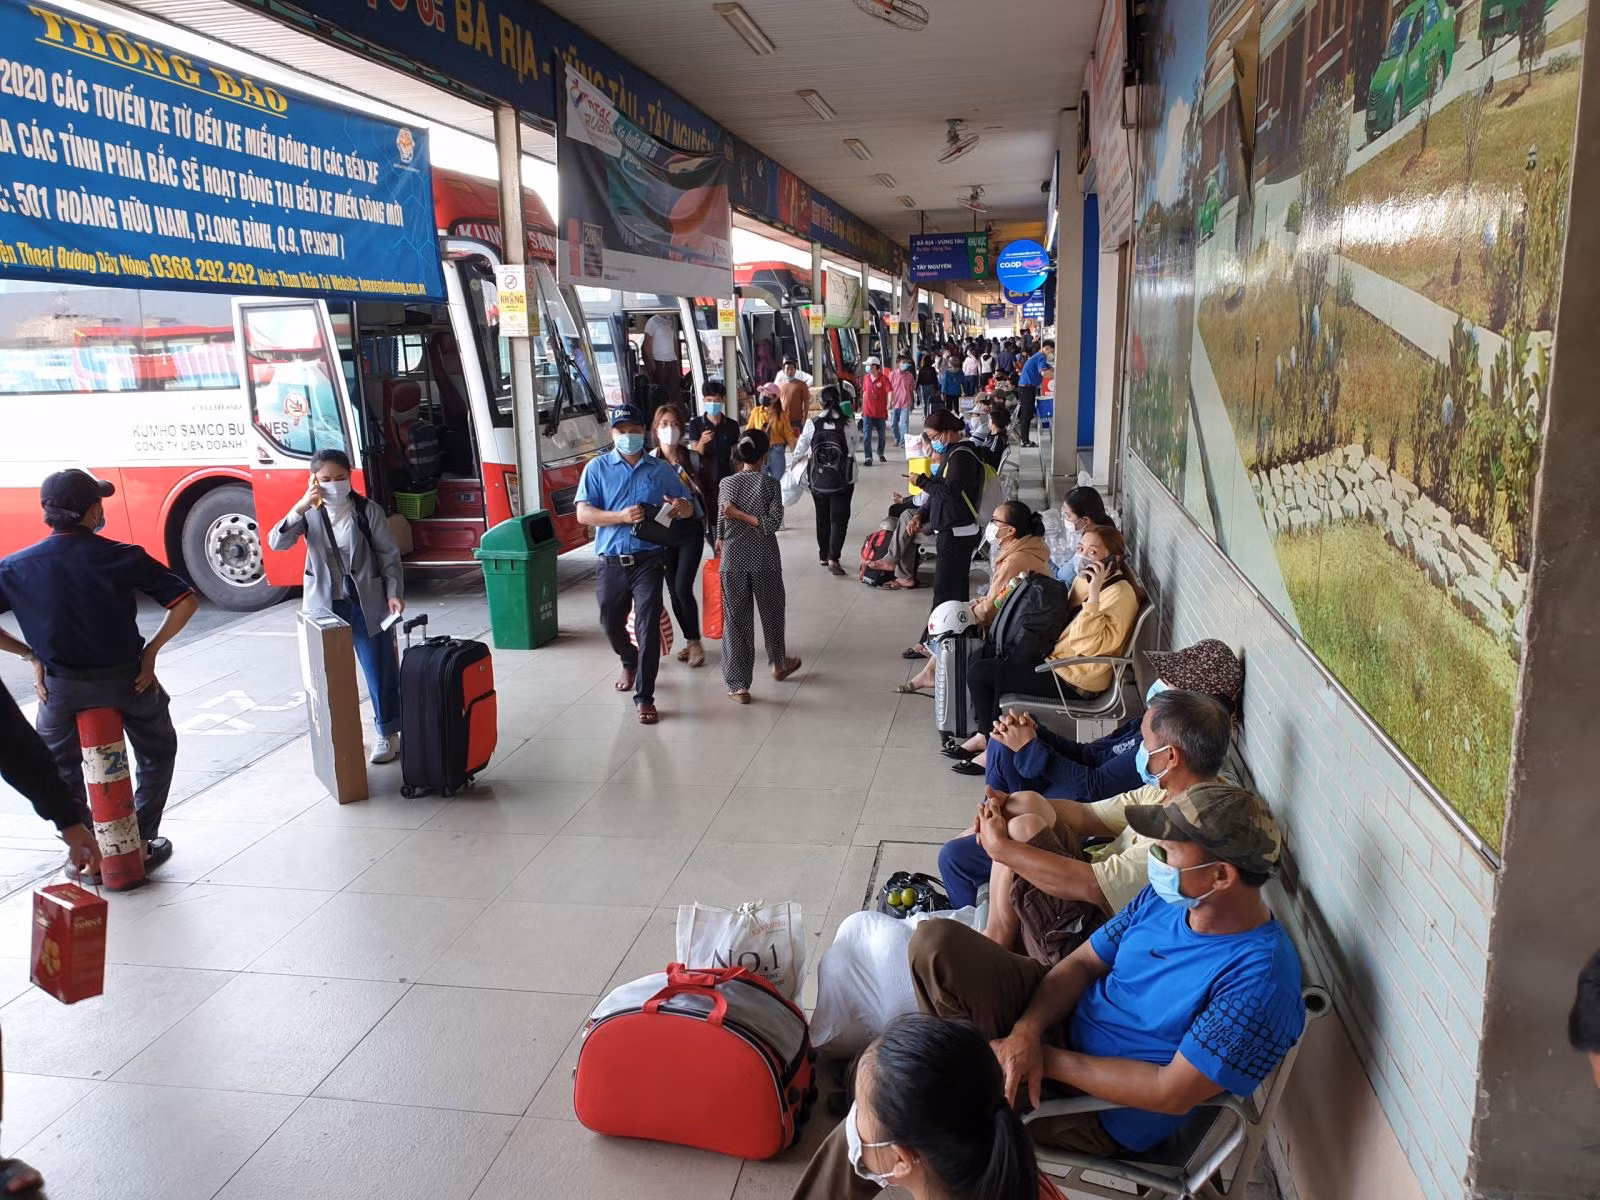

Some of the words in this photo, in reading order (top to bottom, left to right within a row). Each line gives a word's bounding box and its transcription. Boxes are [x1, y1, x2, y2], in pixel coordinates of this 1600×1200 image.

[51, 69, 90, 114] CÁC
[92, 83, 147, 129] TUYẾN
[149, 99, 171, 135] XE
[172, 102, 193, 140] TỪ
[194, 107, 223, 148] BẾN
[225, 121, 242, 153] XE
[244, 122, 276, 161] MIỀN
[278, 133, 309, 170] ĐÔNG
[310, 144, 322, 172] ĐI
[323, 146, 344, 177] CÁC
[345, 150, 366, 182] BẾN
[366, 160, 380, 185] XE
[17, 118, 58, 164] CÁC
[58, 122, 104, 173] TỈNH
[103, 140, 146, 181] PHÍA
[146, 143, 179, 188] BẮC
[181, 156, 201, 192] SẼ
[202, 164, 237, 204] HOẠT
[239, 169, 274, 209] ĐỘNG
[274, 179, 294, 214] TẠI
[295, 178, 319, 211] BẾN
[319, 188, 333, 216] XE
[359, 194, 386, 225] ĐÔNG
[12, 181, 51, 221] 501
[55, 185, 119, 230] HOÀNG
[118, 195, 153, 235] HỮU
[16, 241, 55, 272] Thoại
[973, 255, 985, 275] 3
[180, 423, 224, 437] SAMCO
